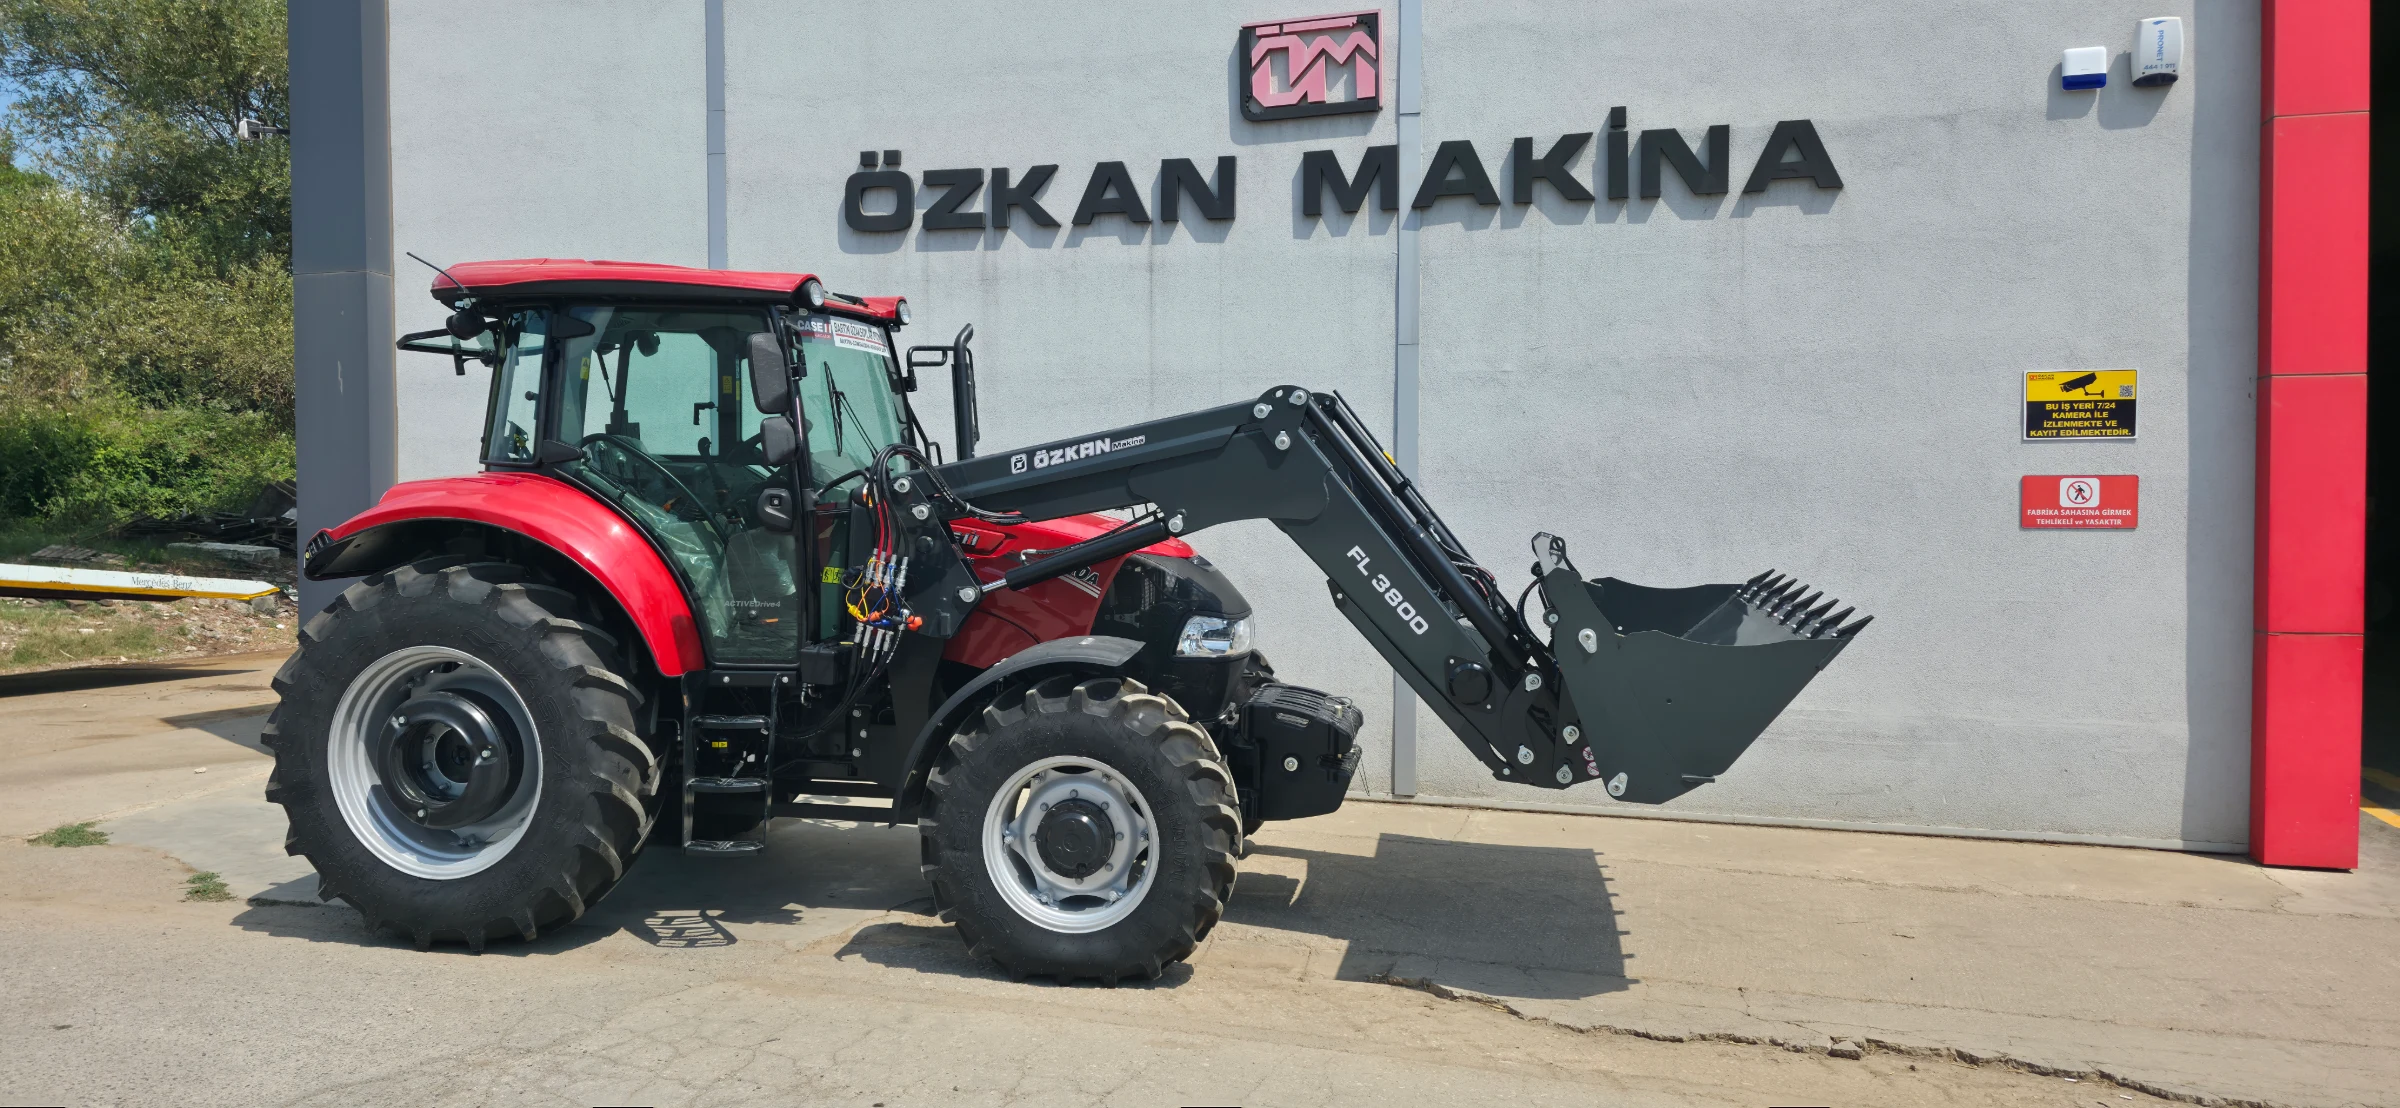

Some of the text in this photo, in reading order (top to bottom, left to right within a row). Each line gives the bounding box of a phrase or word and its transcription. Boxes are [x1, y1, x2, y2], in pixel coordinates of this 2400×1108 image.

[2156, 29, 2164, 61] PRONET
[844, 106, 1843, 232] ÖZKAN MAKİNA
[797, 319, 823, 332] CASE
[2045, 401, 2116, 412] BU İŞ YERİ 7/24
[2052, 410, 2109, 419] KAMERA İLE
[2043, 419, 2103, 428] İZLENMEKTE
[2030, 427, 2132, 437] KAYIT EDİLMEKTEDİR.
[1033, 437, 1111, 470] ÖZKAN
[1112, 436, 1145, 451] Makina
[2027, 508, 2132, 516] FABRİKA SAHASINA GİRMEK
[2036, 517, 2073, 526] TEHLİKELİ
[2085, 518, 2122, 526] YASAKTIR
[1346, 545, 1429, 636] FL 3800
[723, 600, 781, 608] ACTIVEDrive4
